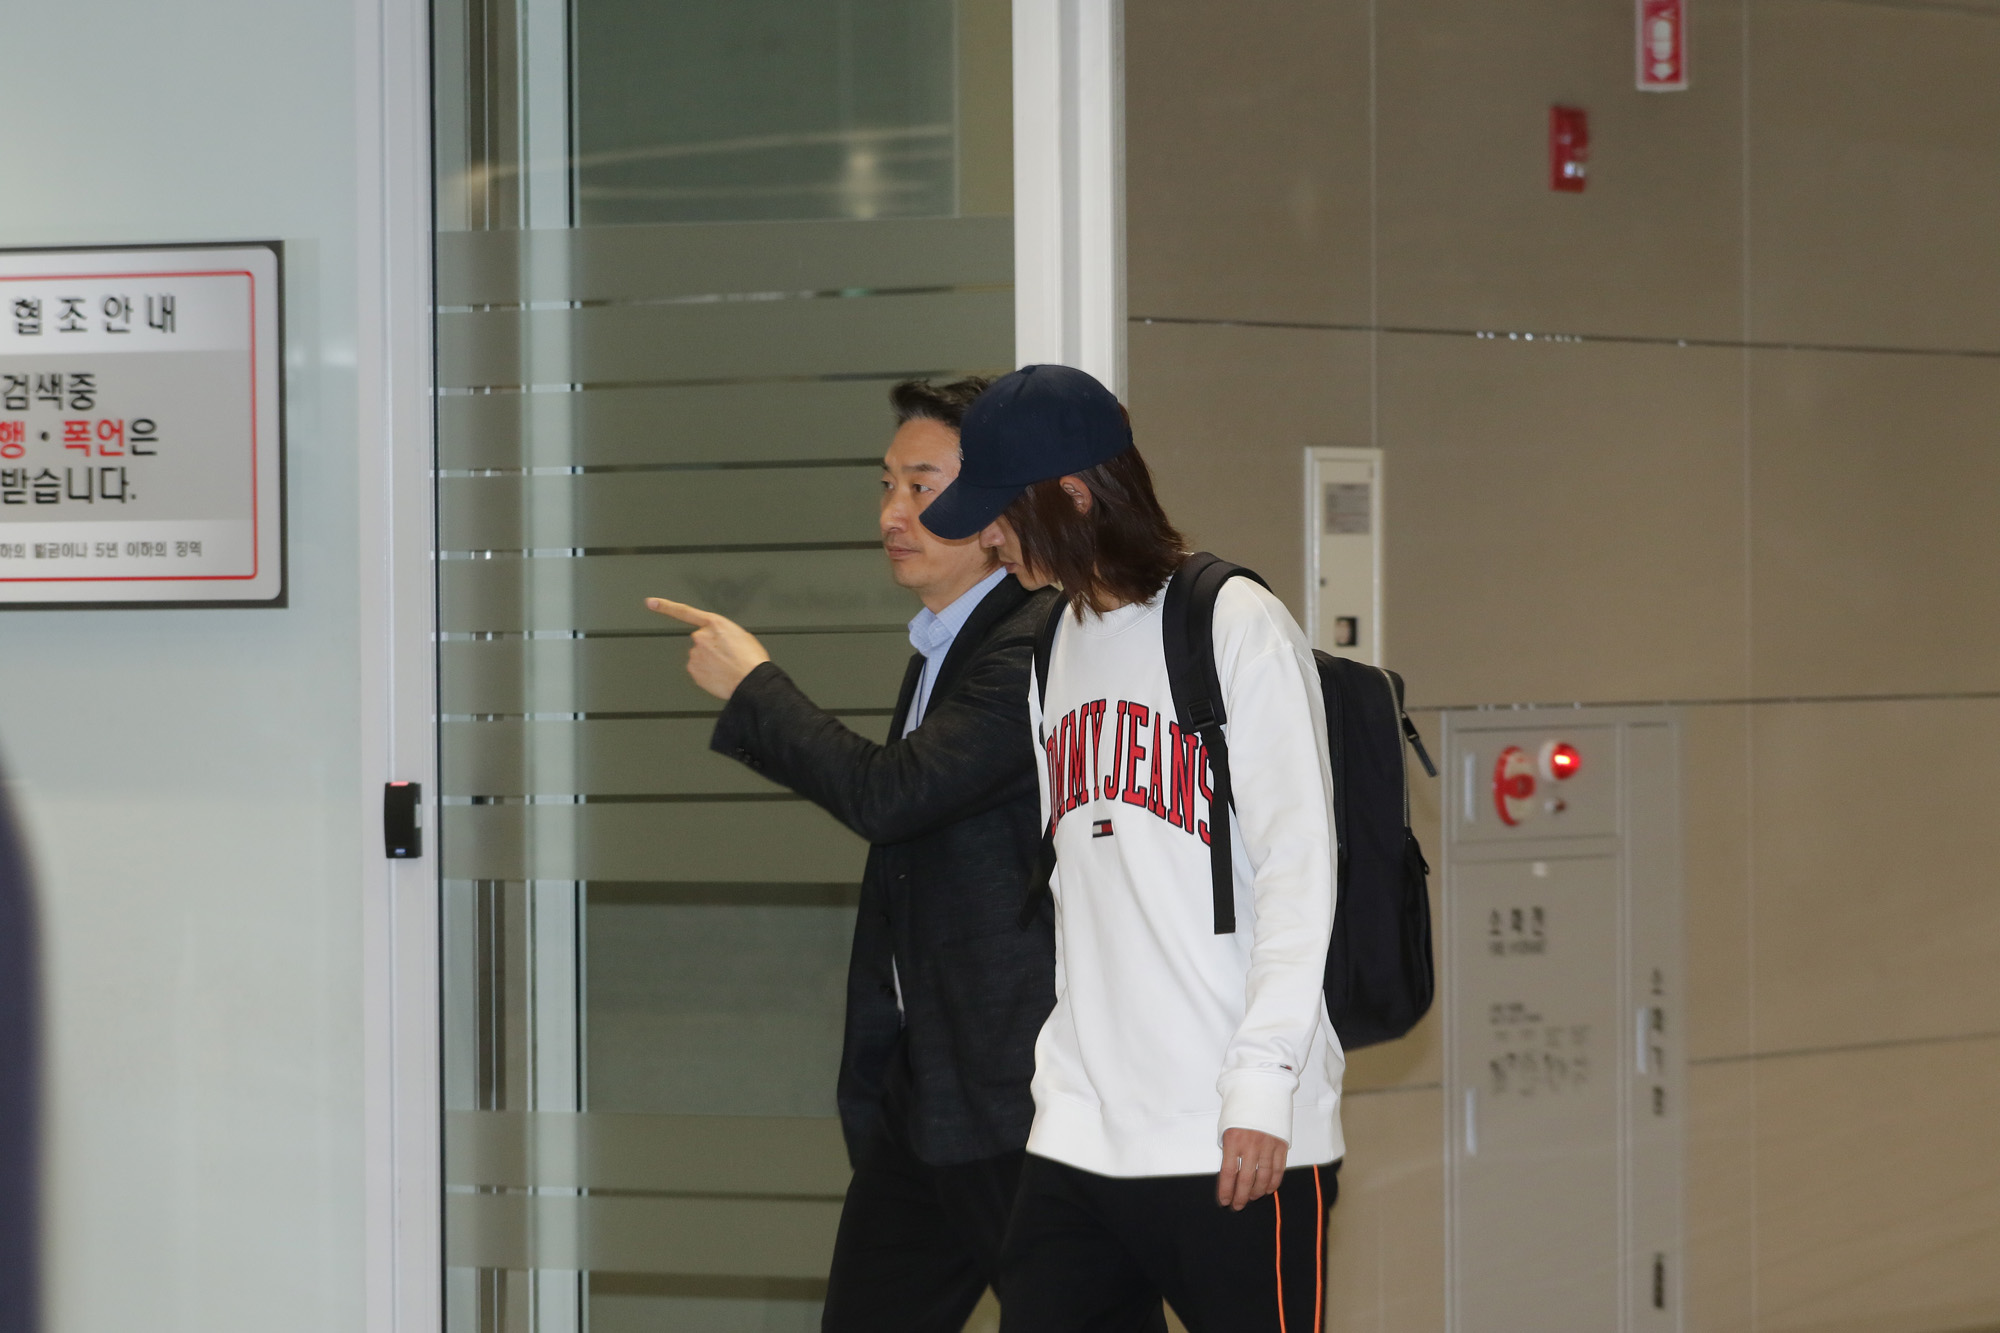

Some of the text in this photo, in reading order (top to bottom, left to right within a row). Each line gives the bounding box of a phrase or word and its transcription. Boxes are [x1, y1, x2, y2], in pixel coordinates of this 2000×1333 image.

[2, 373, 97, 411] 검색중
[63, 418, 158, 458] 폭언은
[0, 466, 137, 505] 받습니다.
[127, 541, 168, 558] 이하의
[1046, 699, 1213, 847] OMMY JEANS
